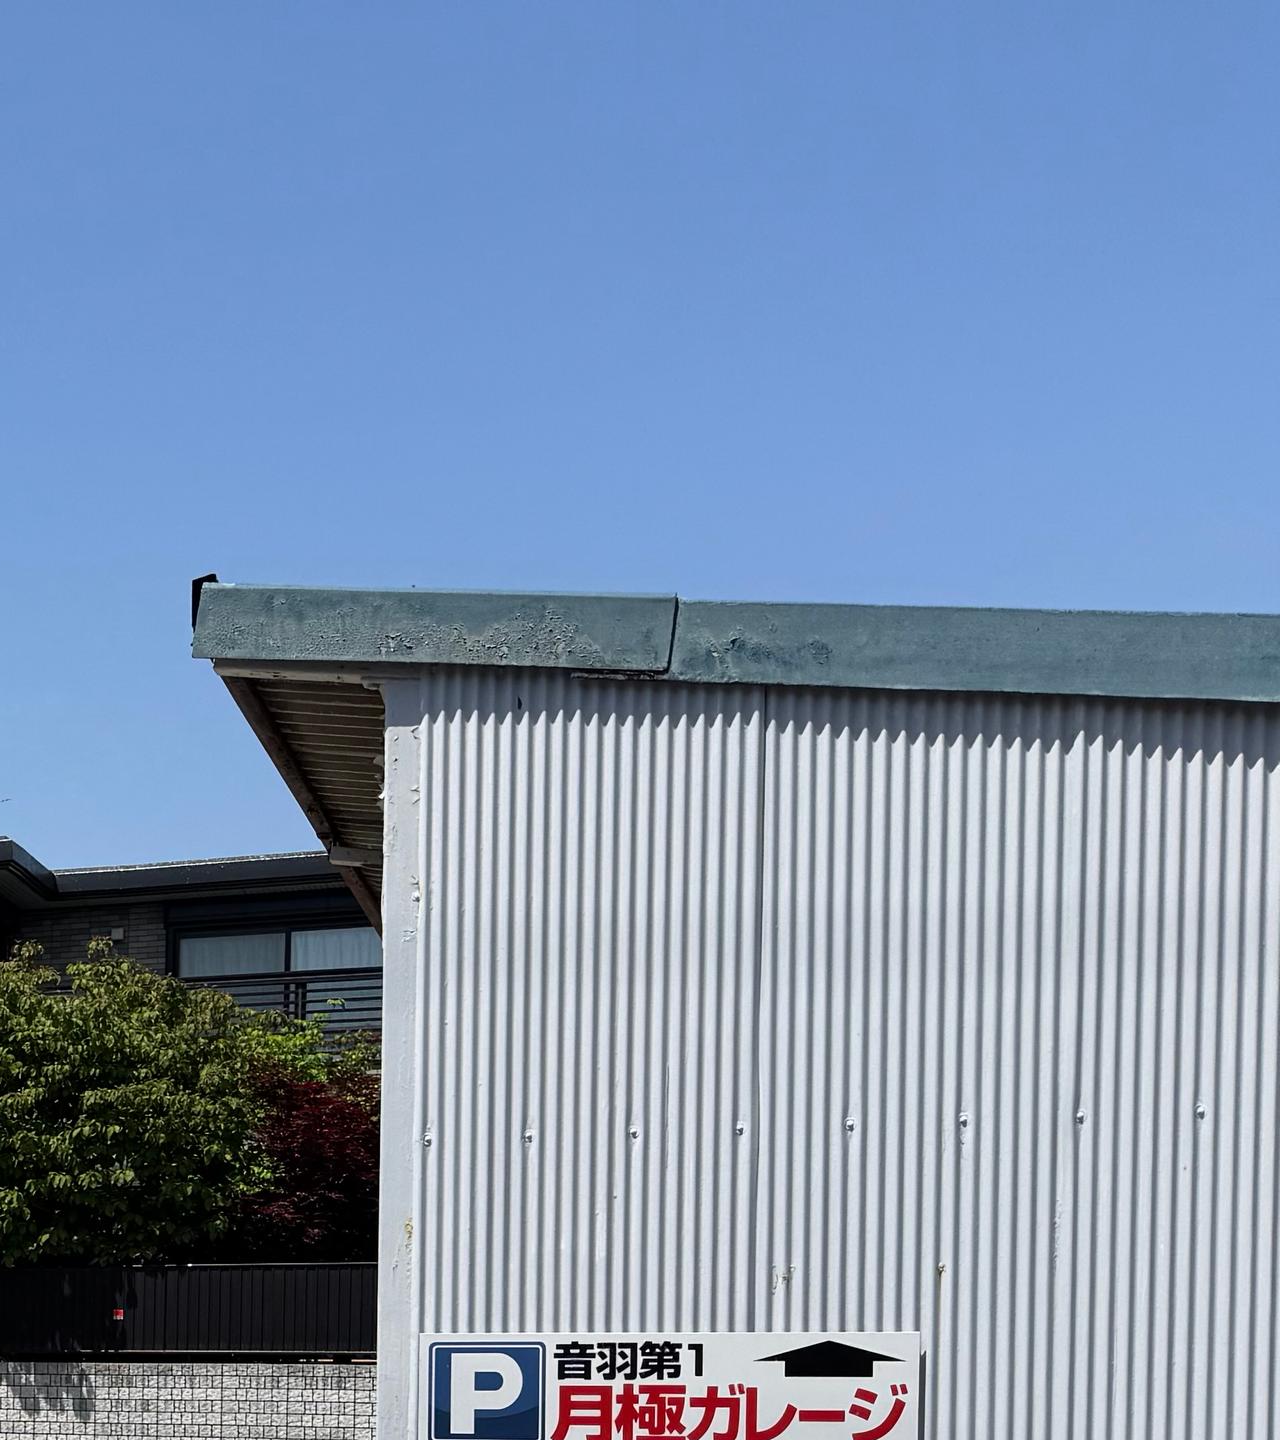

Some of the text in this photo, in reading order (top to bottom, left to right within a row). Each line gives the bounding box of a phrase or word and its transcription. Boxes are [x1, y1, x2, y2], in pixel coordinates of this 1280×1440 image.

[553, 1341, 704, 1381] 音羽第1
[450, 1352, 524, 1435] P
